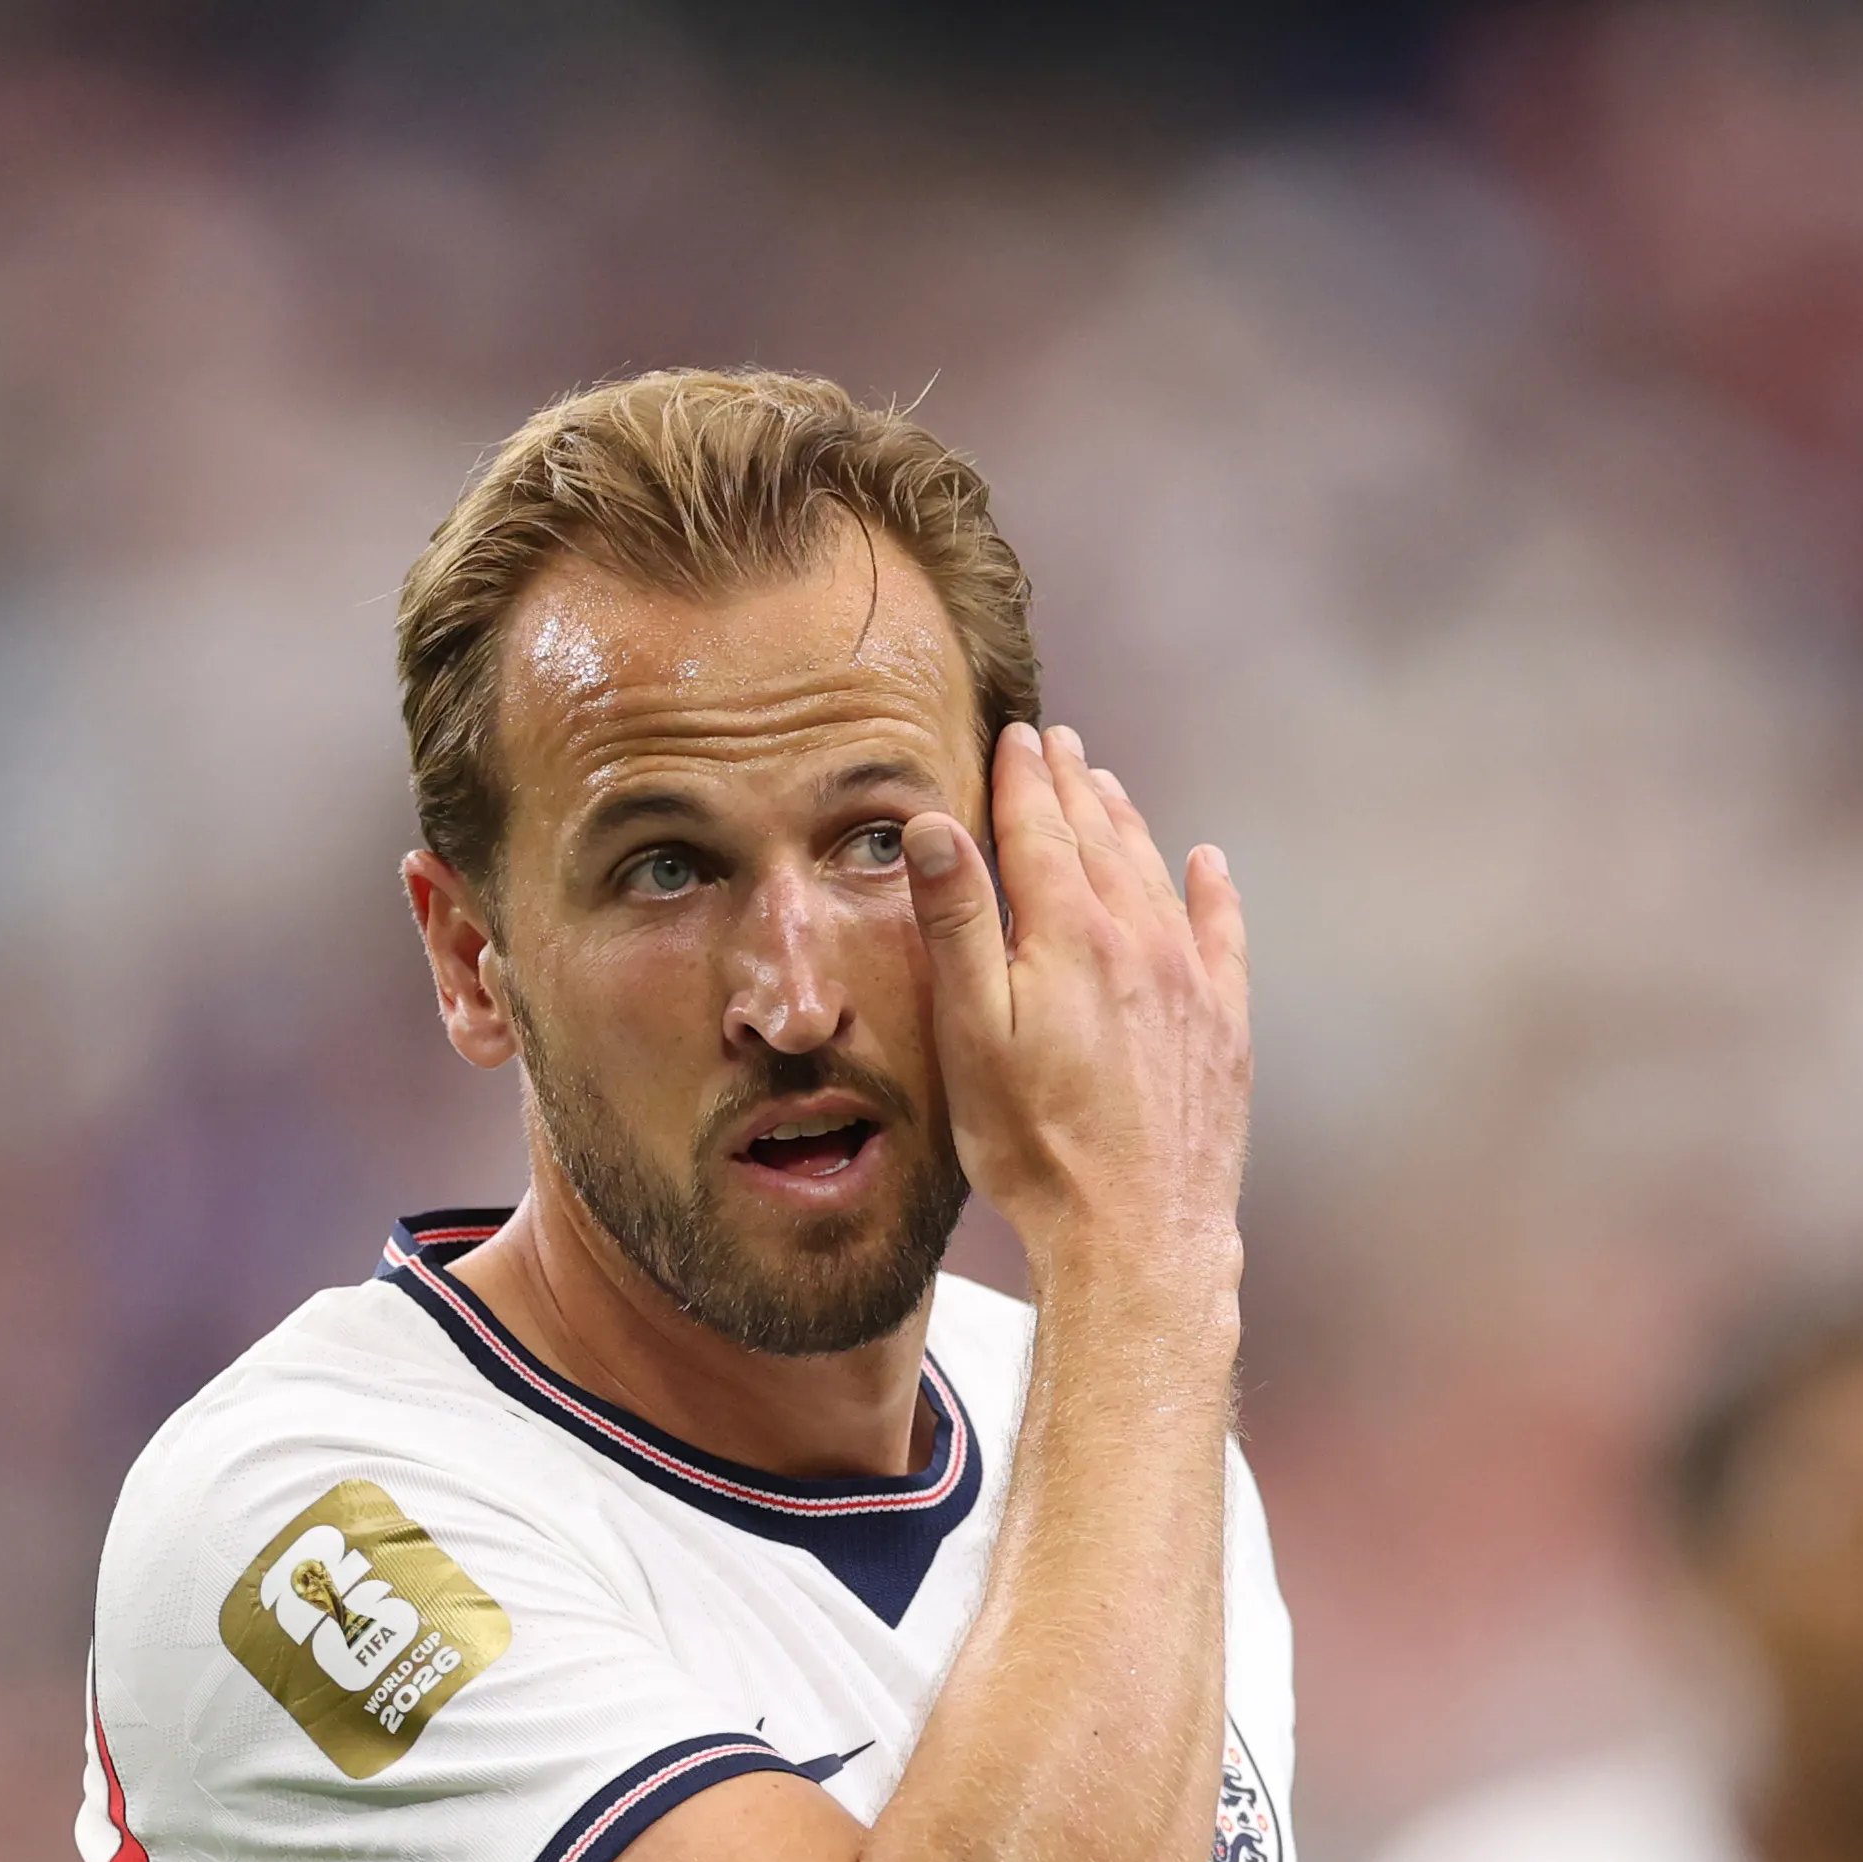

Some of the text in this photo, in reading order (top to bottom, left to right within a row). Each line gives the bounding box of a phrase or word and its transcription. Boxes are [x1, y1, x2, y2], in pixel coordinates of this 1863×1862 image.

[354, 1626, 397, 1668] FIFA
[363, 1631, 443, 1715] WORLD CUP
[379, 1645, 462, 1735] 2026
